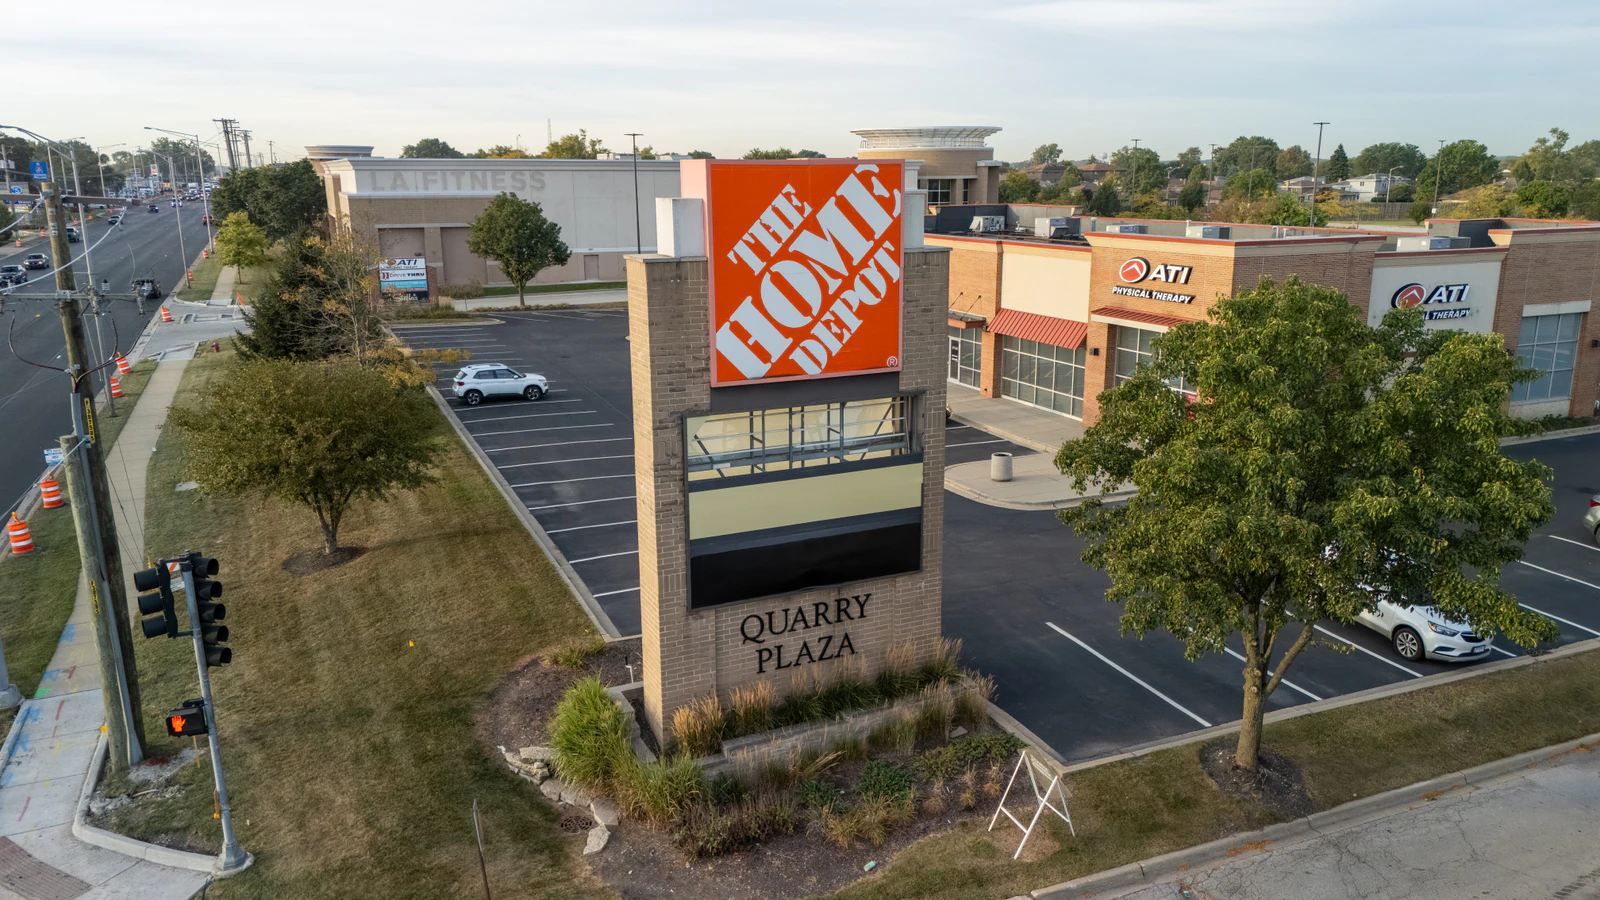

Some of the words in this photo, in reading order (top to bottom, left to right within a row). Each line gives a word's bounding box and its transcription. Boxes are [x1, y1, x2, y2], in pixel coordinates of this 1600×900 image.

[370, 171, 410, 191] LA
[422, 171, 546, 191] FITNESS
[727, 183, 812, 276] THE
[716, 164, 901, 379] HOME
[1148, 263, 1192, 284] ATI
[789, 240, 900, 375] DEPOT
[1112, 285, 1151, 299] PHYSICAL
[1152, 290, 1195, 304] THERAPY
[1424, 284, 1470, 304] ATI
[1432, 308, 1471, 320] THERAPY
[740, 593, 872, 645] QUARRY
[755, 632, 857, 674] PLAZA
